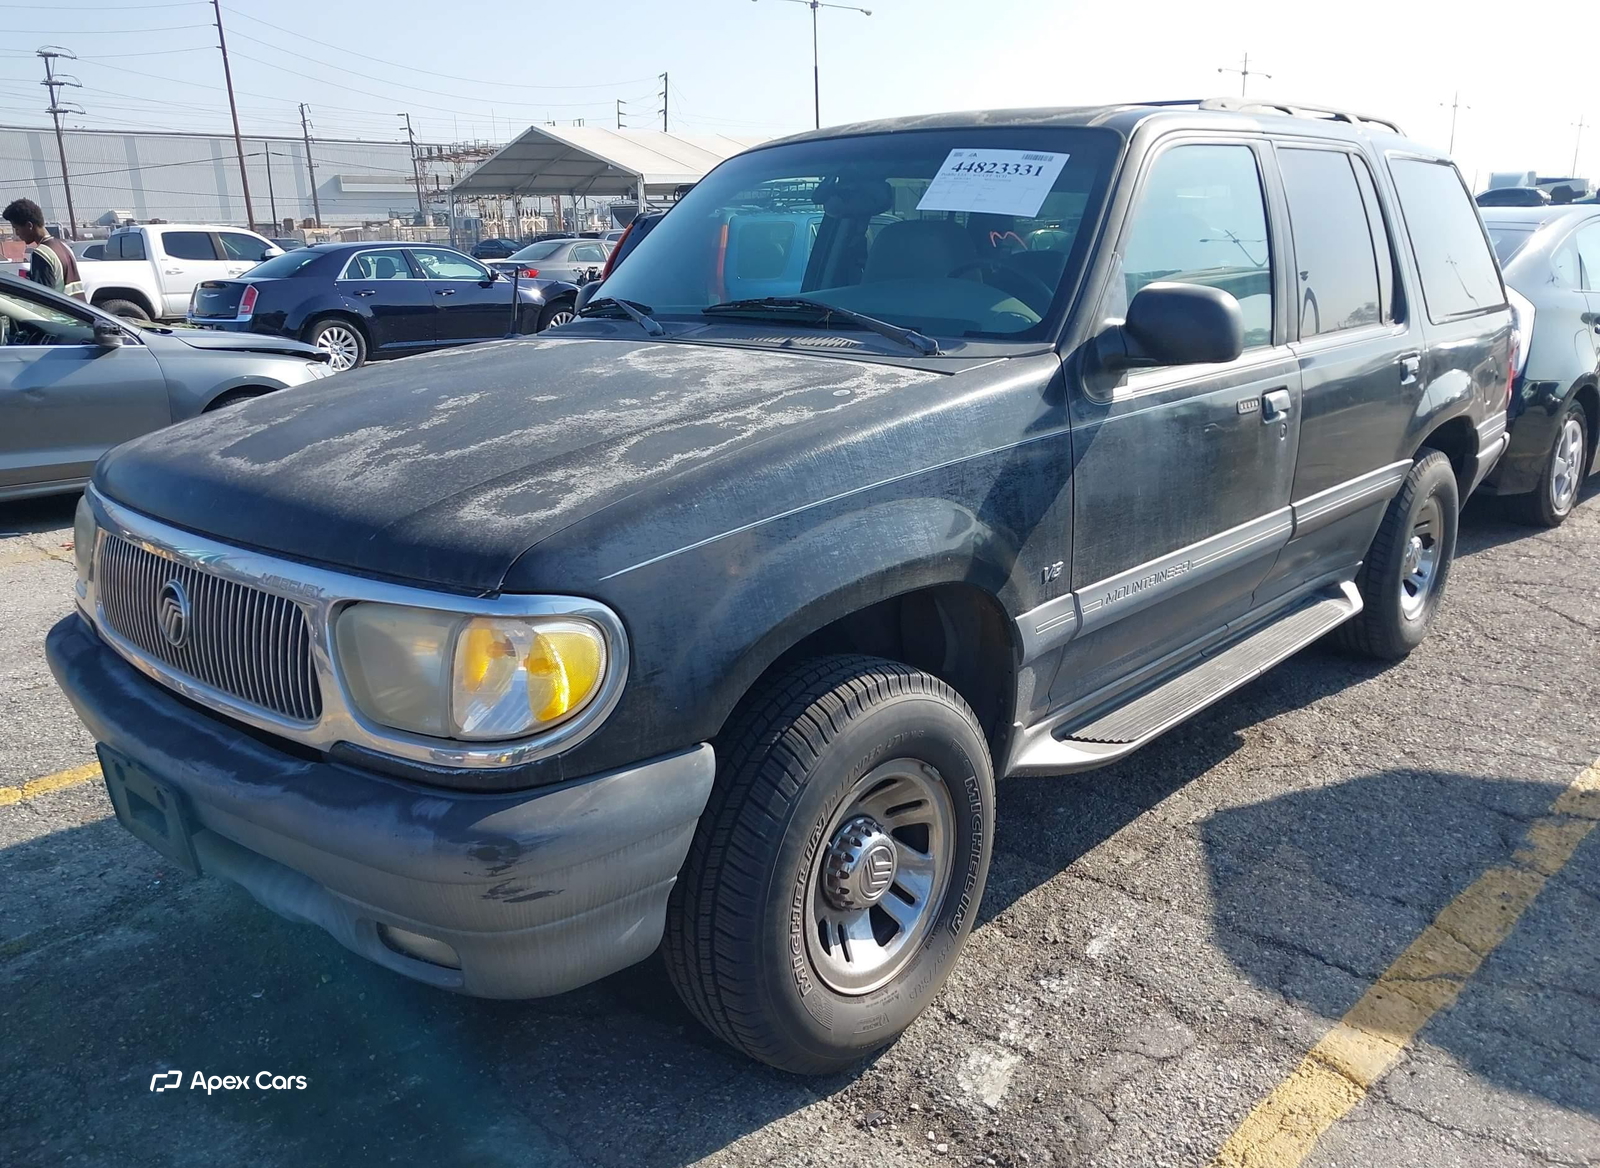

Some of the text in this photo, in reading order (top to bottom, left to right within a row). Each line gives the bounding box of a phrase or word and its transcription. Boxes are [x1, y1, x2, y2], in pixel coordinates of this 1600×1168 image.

[951, 161, 1043, 176] 44823331
[259, 573, 326, 598] MERCURY
[1042, 560, 1064, 584] V8
[1105, 560, 1191, 605] MOUNTAINEER
[950, 775, 984, 937] MICHELIN
[789, 812, 827, 998] MICHELIN
